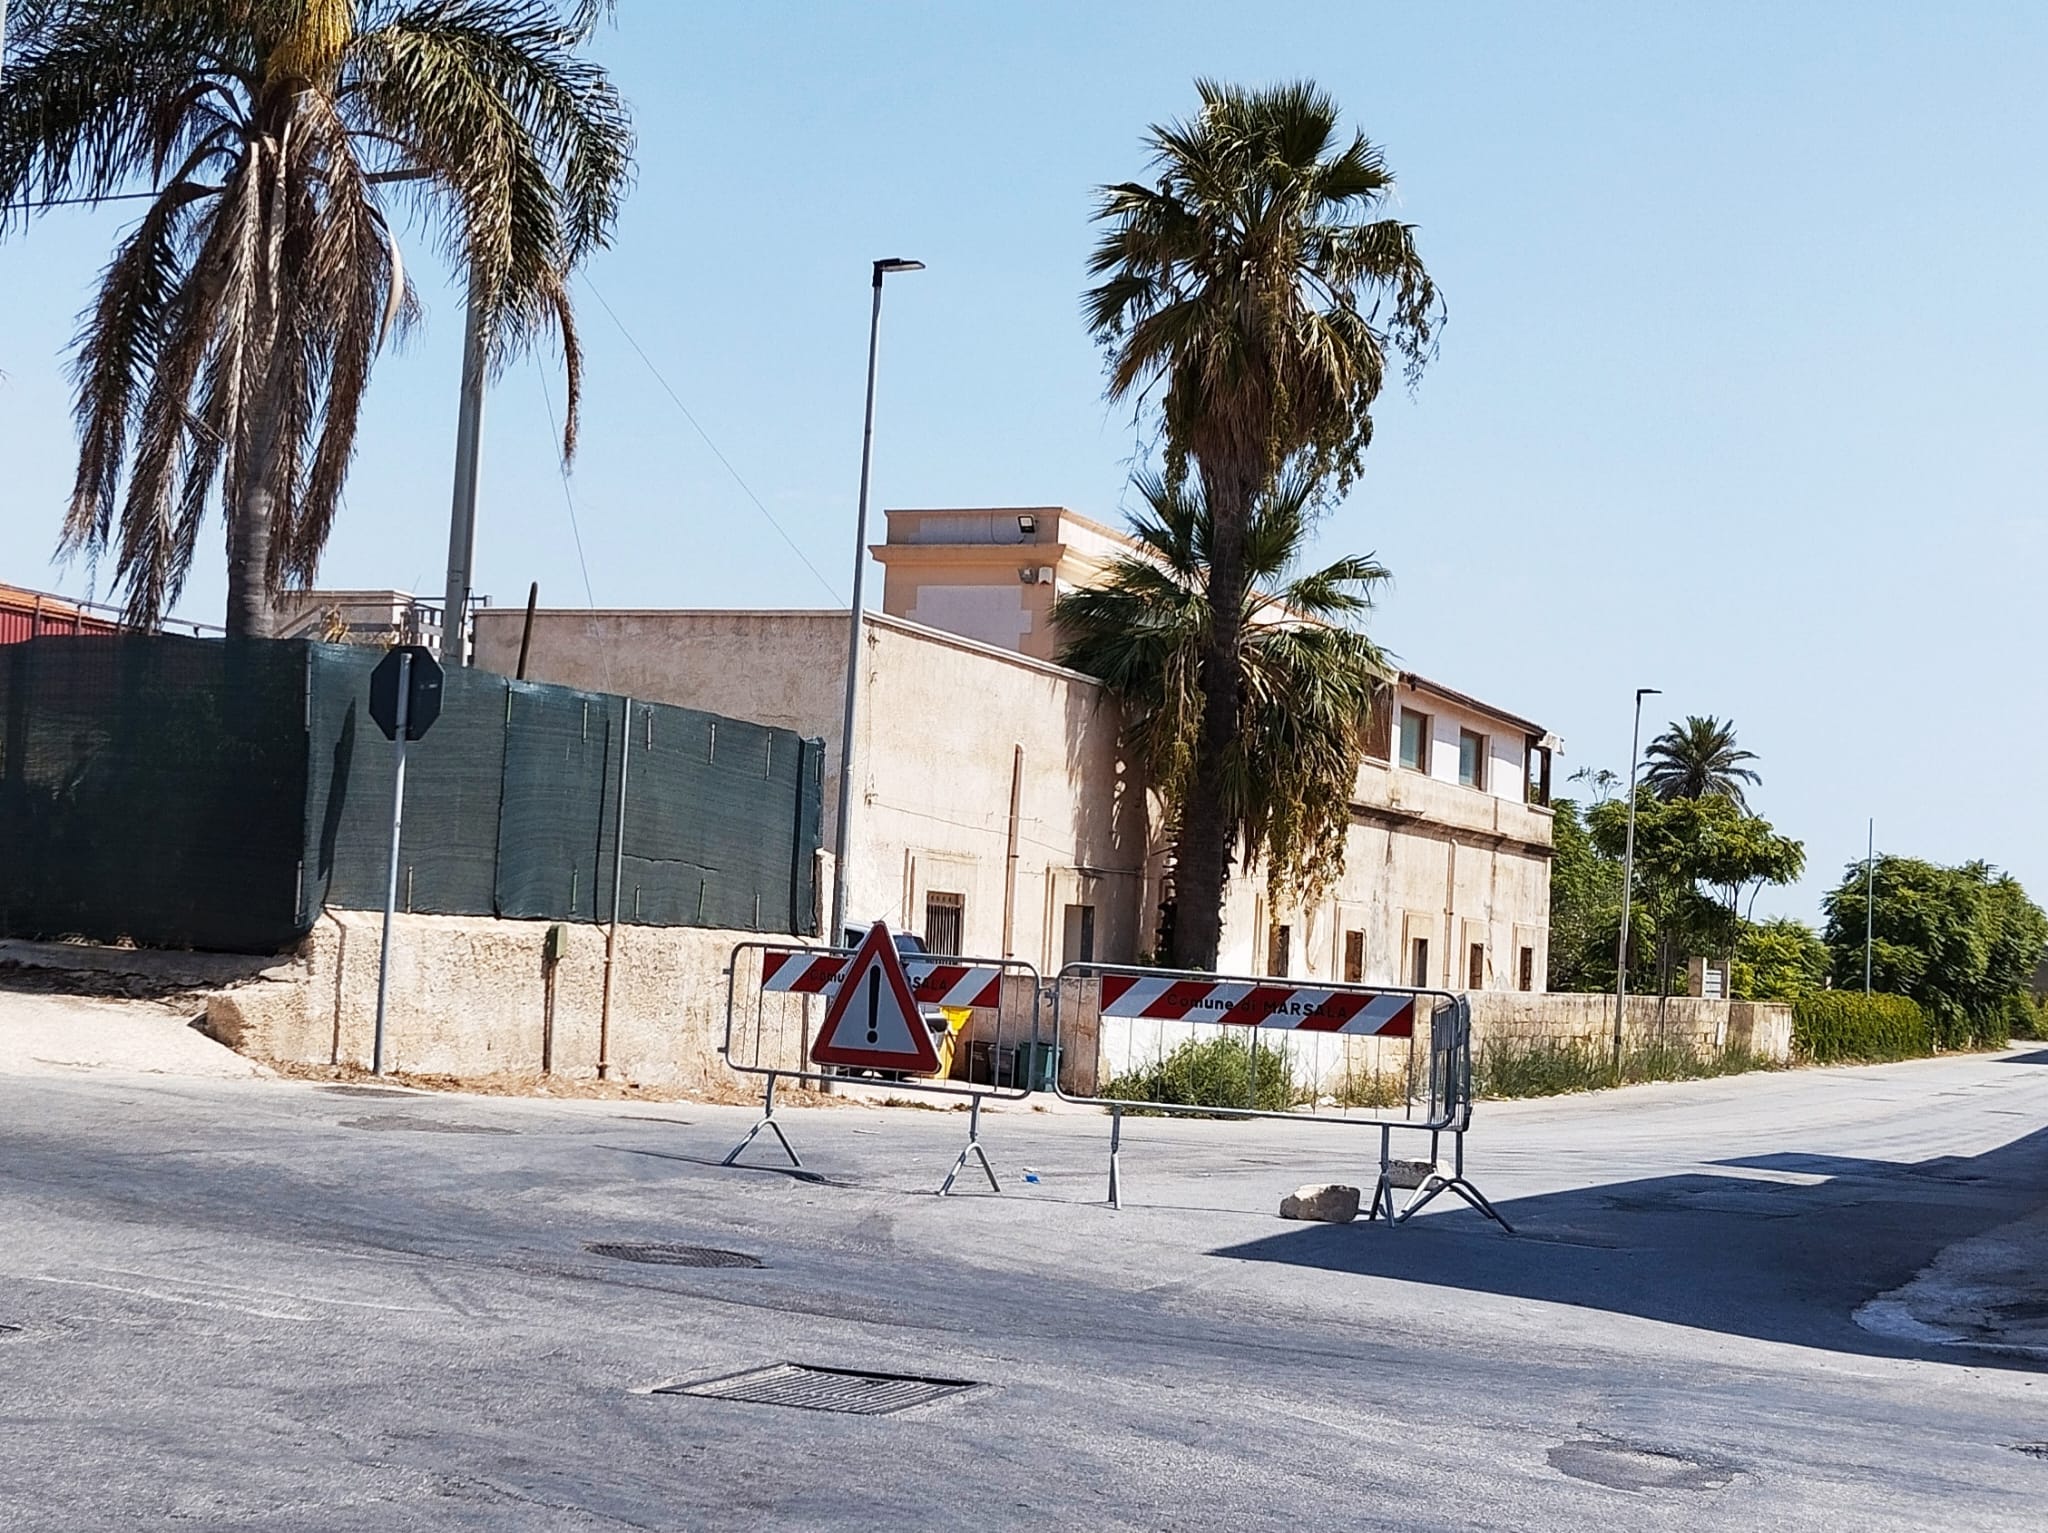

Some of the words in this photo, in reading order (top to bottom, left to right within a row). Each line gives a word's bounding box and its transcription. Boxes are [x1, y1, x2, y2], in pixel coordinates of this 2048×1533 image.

[808, 967, 845, 983] Comu
[907, 975, 947, 990] SALA
[1167, 993, 1234, 1011] Comune
[1241, 998, 1256, 1013] di
[1263, 1000, 1347, 1018] MARSALA
